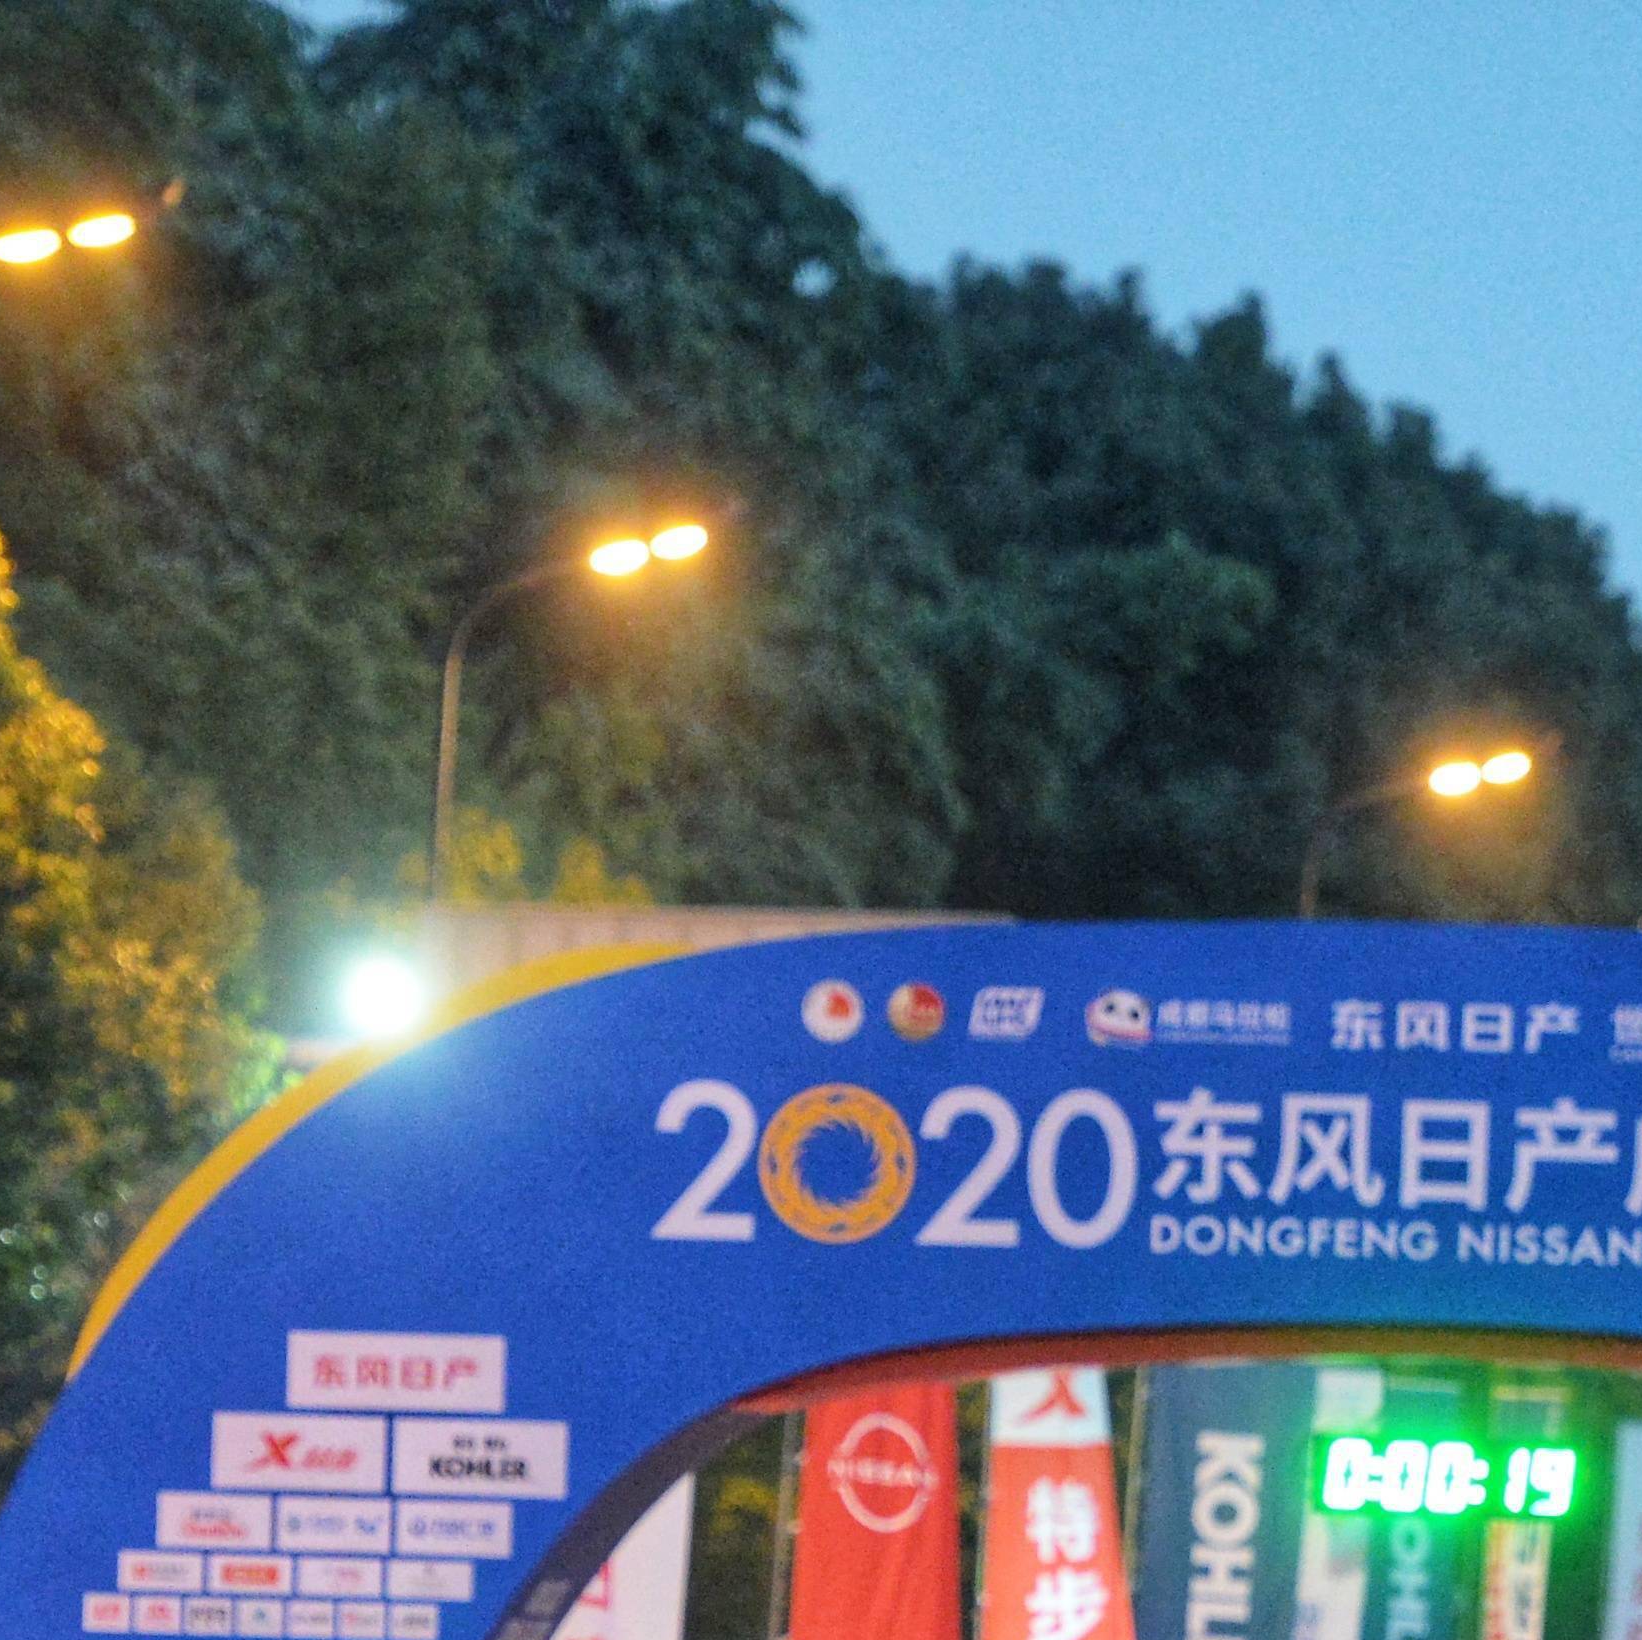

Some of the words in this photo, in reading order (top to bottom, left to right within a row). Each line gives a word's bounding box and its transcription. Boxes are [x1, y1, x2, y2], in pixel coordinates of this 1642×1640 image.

[1331, 999, 1580, 1053] 东风日产
[650, 1078, 1139, 1250] 2020
[1149, 1213, 1440, 1262] DONGFENG
[312, 1354, 479, 1391] 东风日产
[427, 1455, 529, 1482] KOHLER
